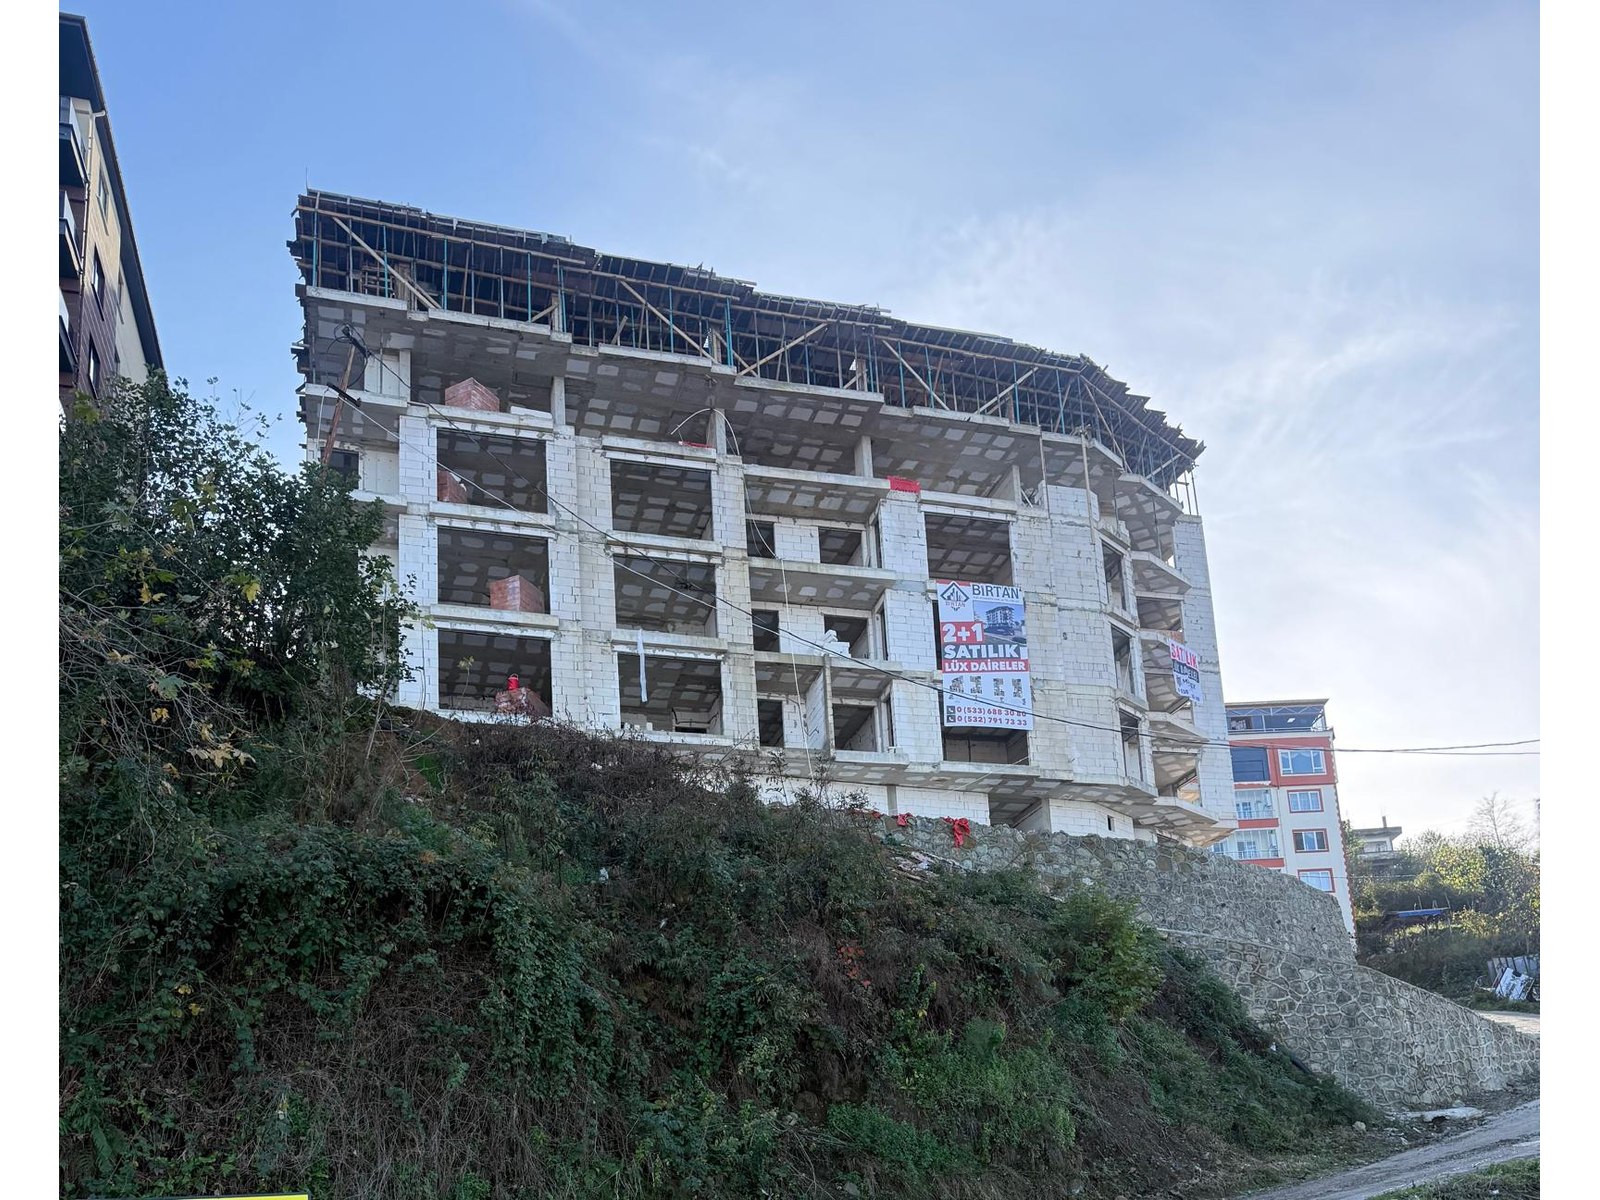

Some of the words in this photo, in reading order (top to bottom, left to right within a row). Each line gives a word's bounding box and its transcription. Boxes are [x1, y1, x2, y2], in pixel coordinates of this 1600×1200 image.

[942, 623, 983, 643] 2+1
[944, 644, 1019, 660] SATILIK
[944, 659, 968, 672] LÜX
[970, 659, 1026, 671] DAİRELER
[963, 706, 986, 715] (533)
[964, 715, 986, 724] (532)
